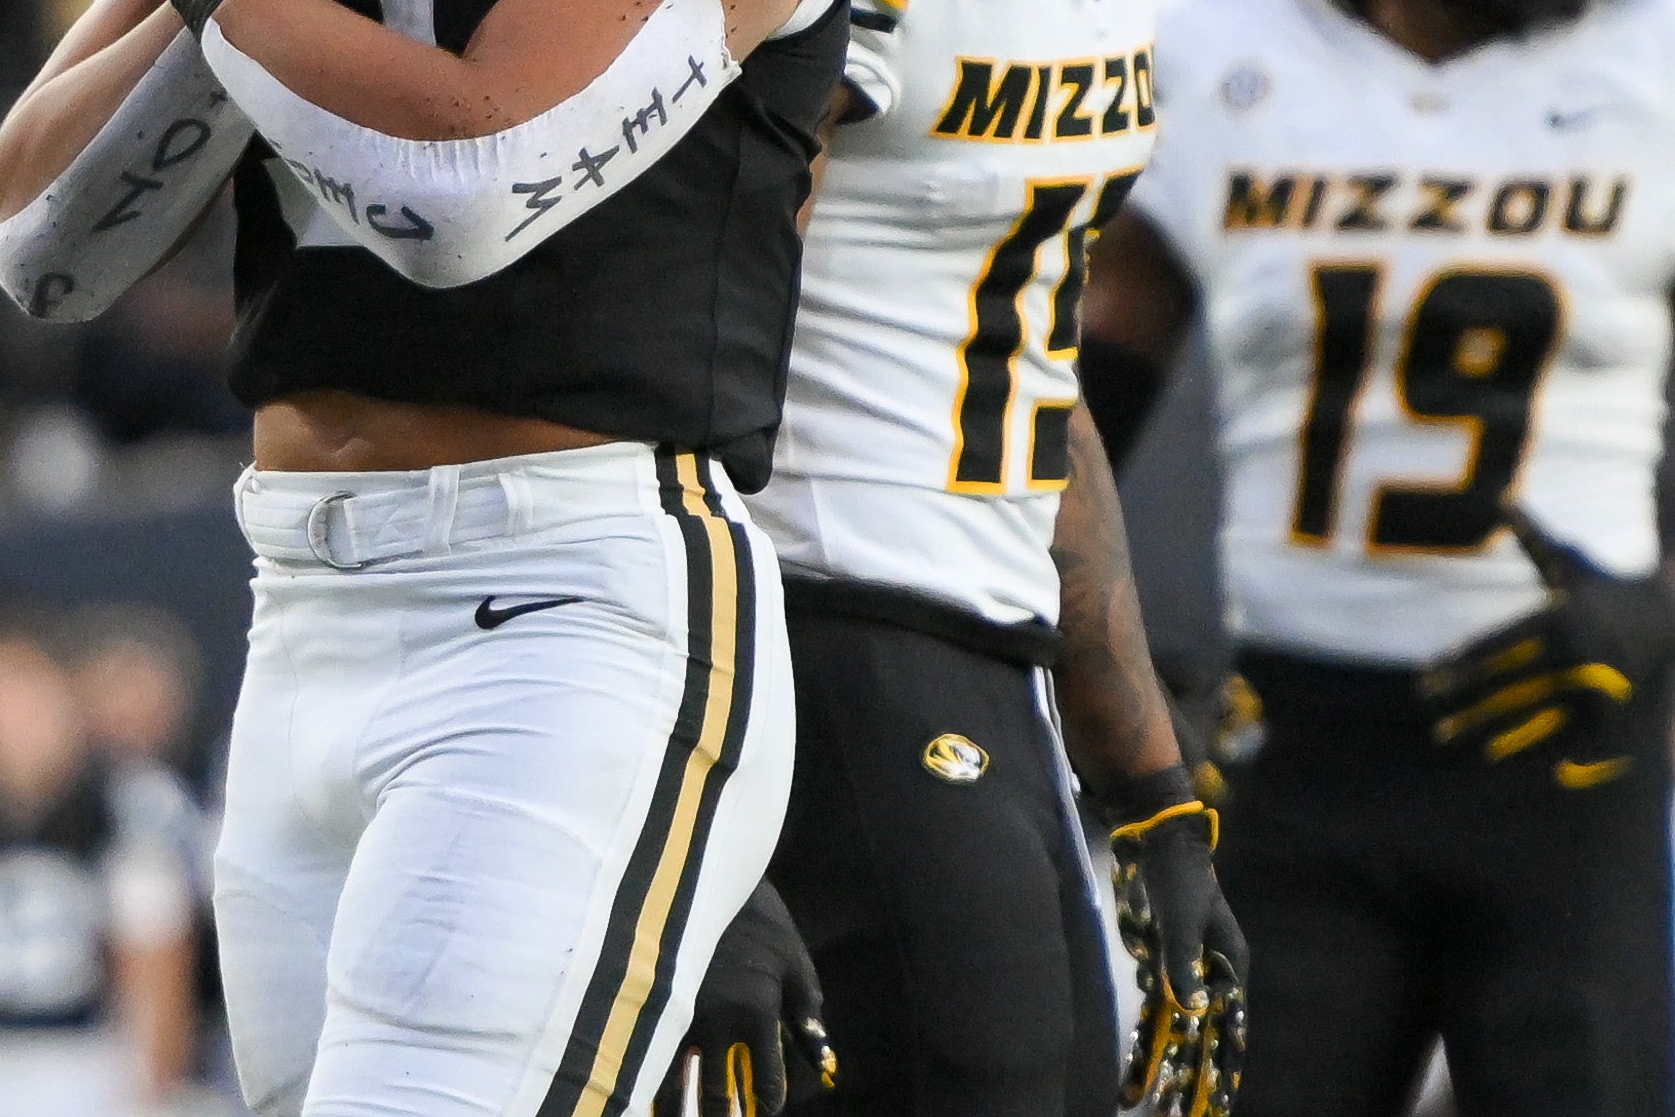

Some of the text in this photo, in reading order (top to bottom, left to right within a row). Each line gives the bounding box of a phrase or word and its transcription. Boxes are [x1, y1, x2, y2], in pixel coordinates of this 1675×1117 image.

[505, 54, 710, 242] TEAM
[1223, 164, 1632, 240] MIZZOU
[1287, 258, 1568, 558] 19
